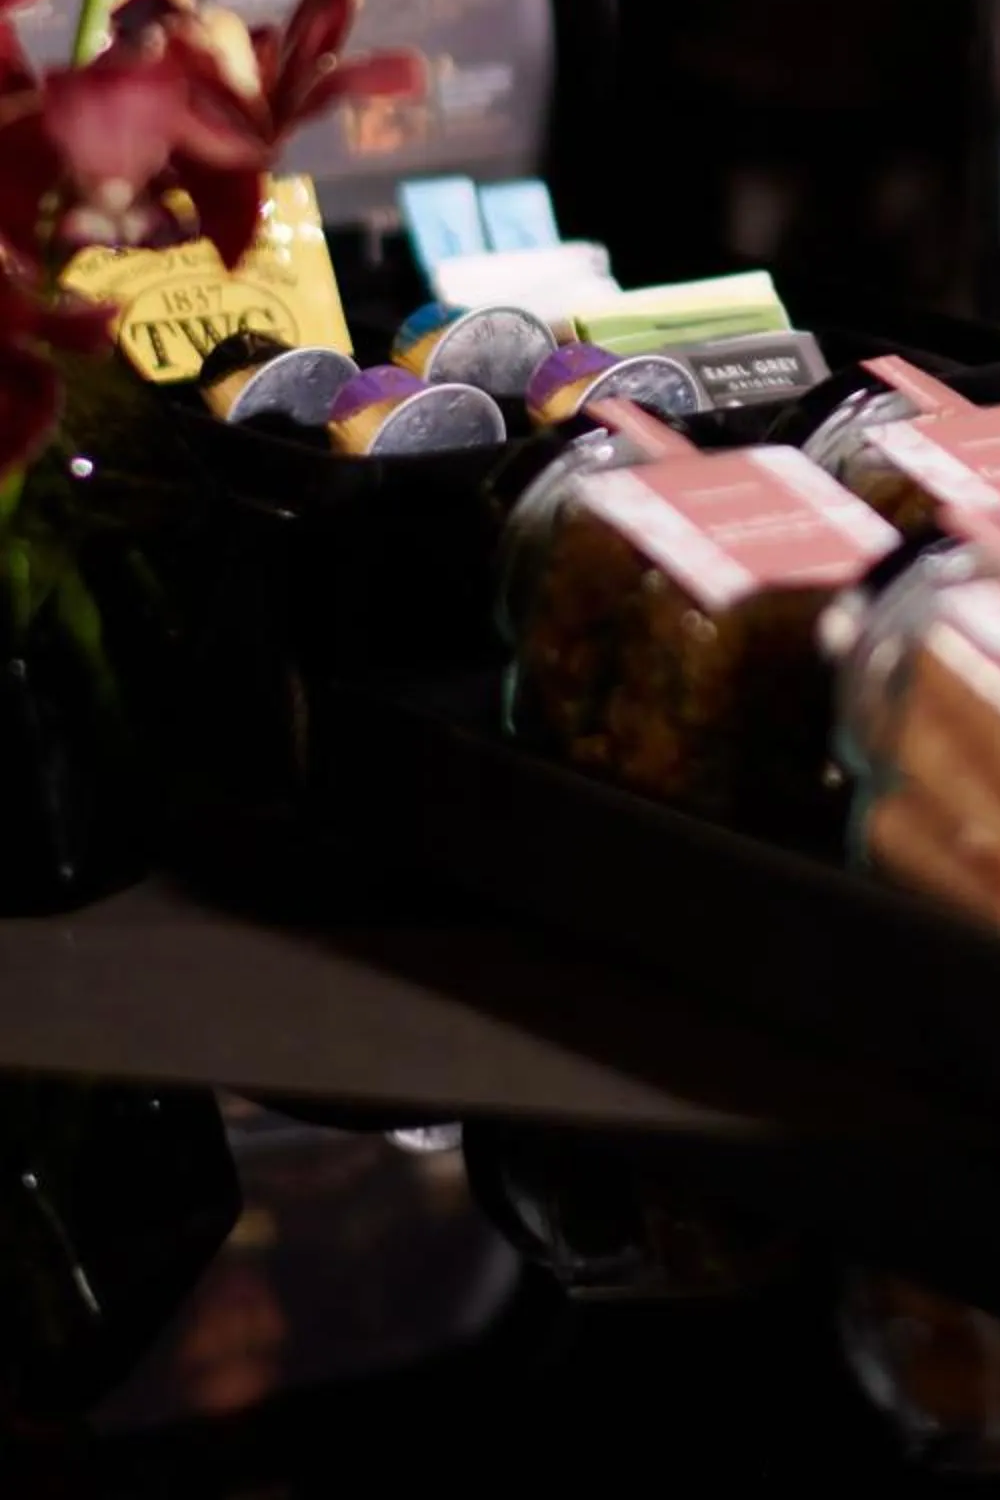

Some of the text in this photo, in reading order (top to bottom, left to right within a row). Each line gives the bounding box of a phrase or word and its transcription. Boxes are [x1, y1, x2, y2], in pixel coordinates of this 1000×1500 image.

[160, 284, 223, 314] 1837
[703, 357, 798, 380] EARL GREY
[729, 376, 793, 391] ORIGINAL
